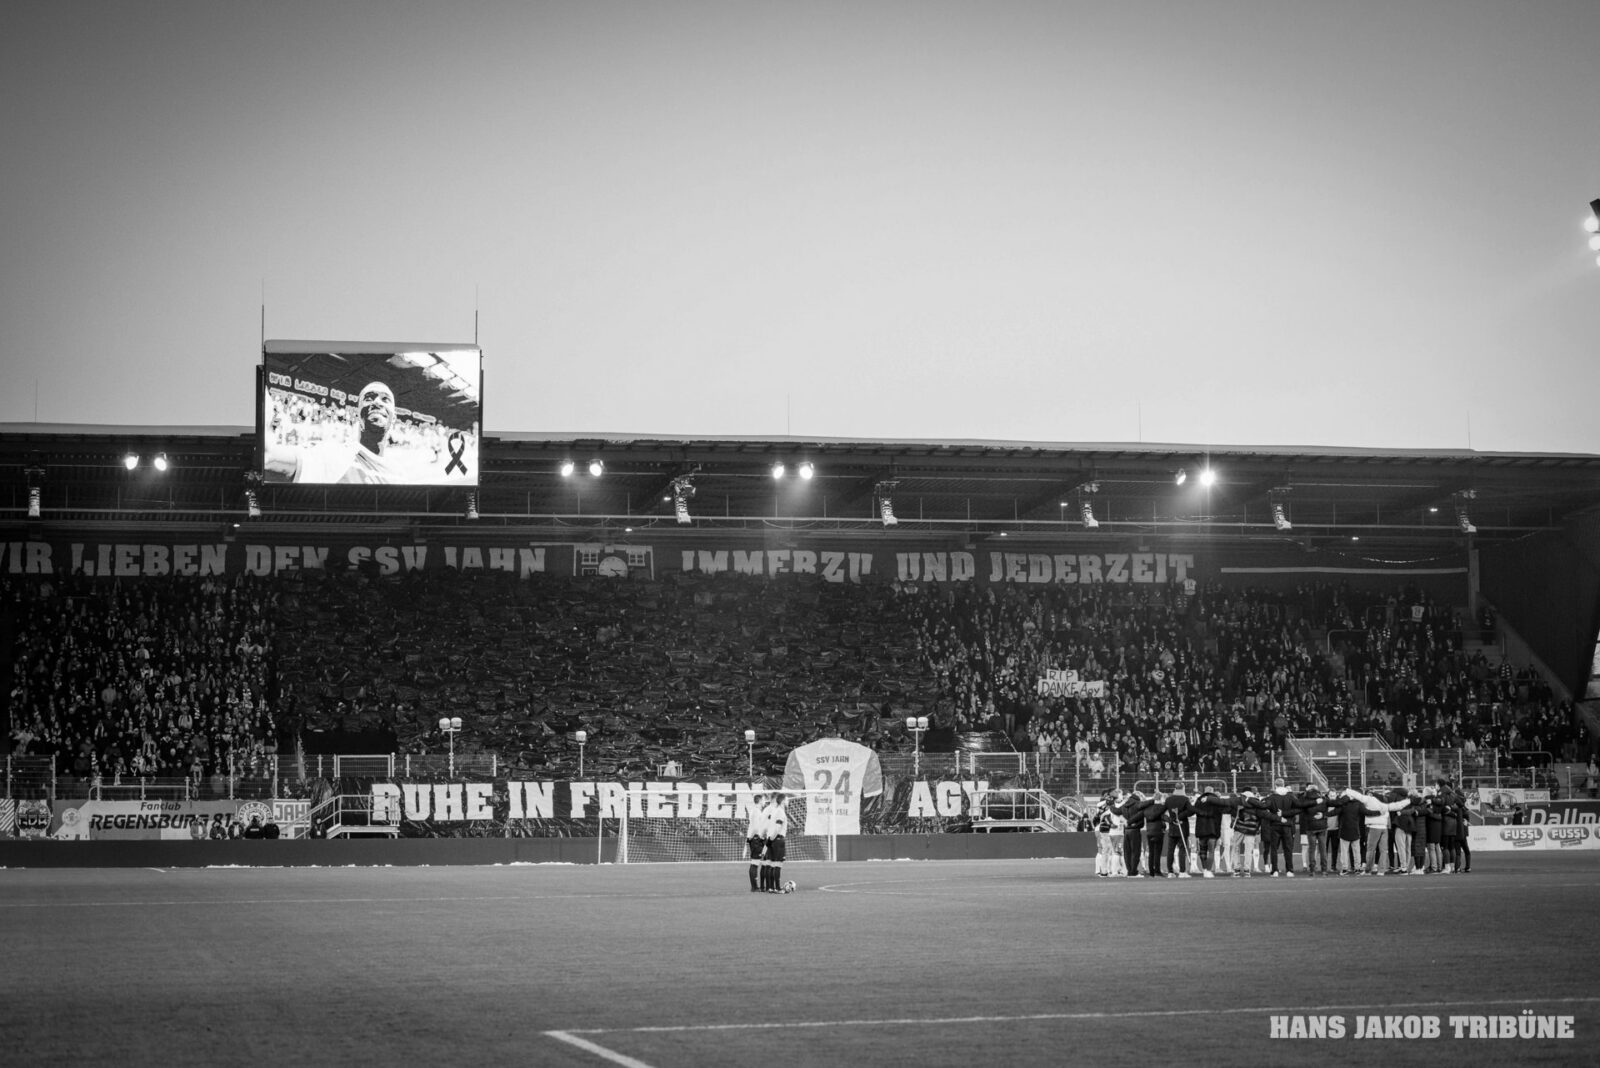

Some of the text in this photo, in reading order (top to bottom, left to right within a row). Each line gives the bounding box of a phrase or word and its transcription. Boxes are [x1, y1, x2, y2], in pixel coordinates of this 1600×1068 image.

[71, 543, 228, 577] LIEBEN
[245, 544, 329, 577] DEN
[681, 550, 1195, 584] IMMERZU UND JEDERZEIT
[1041, 681, 1078, 696] DANKE
[814, 769, 853, 804] 24
[140, 801, 182, 812] Fanclub
[372, 781, 989, 821] RUHE IN FRIEDEN AGY
[1530, 808, 1600, 826] Dallm
[1504, 829, 1541, 840] FUSSL
[1552, 828, 1587, 839] FUSSL
